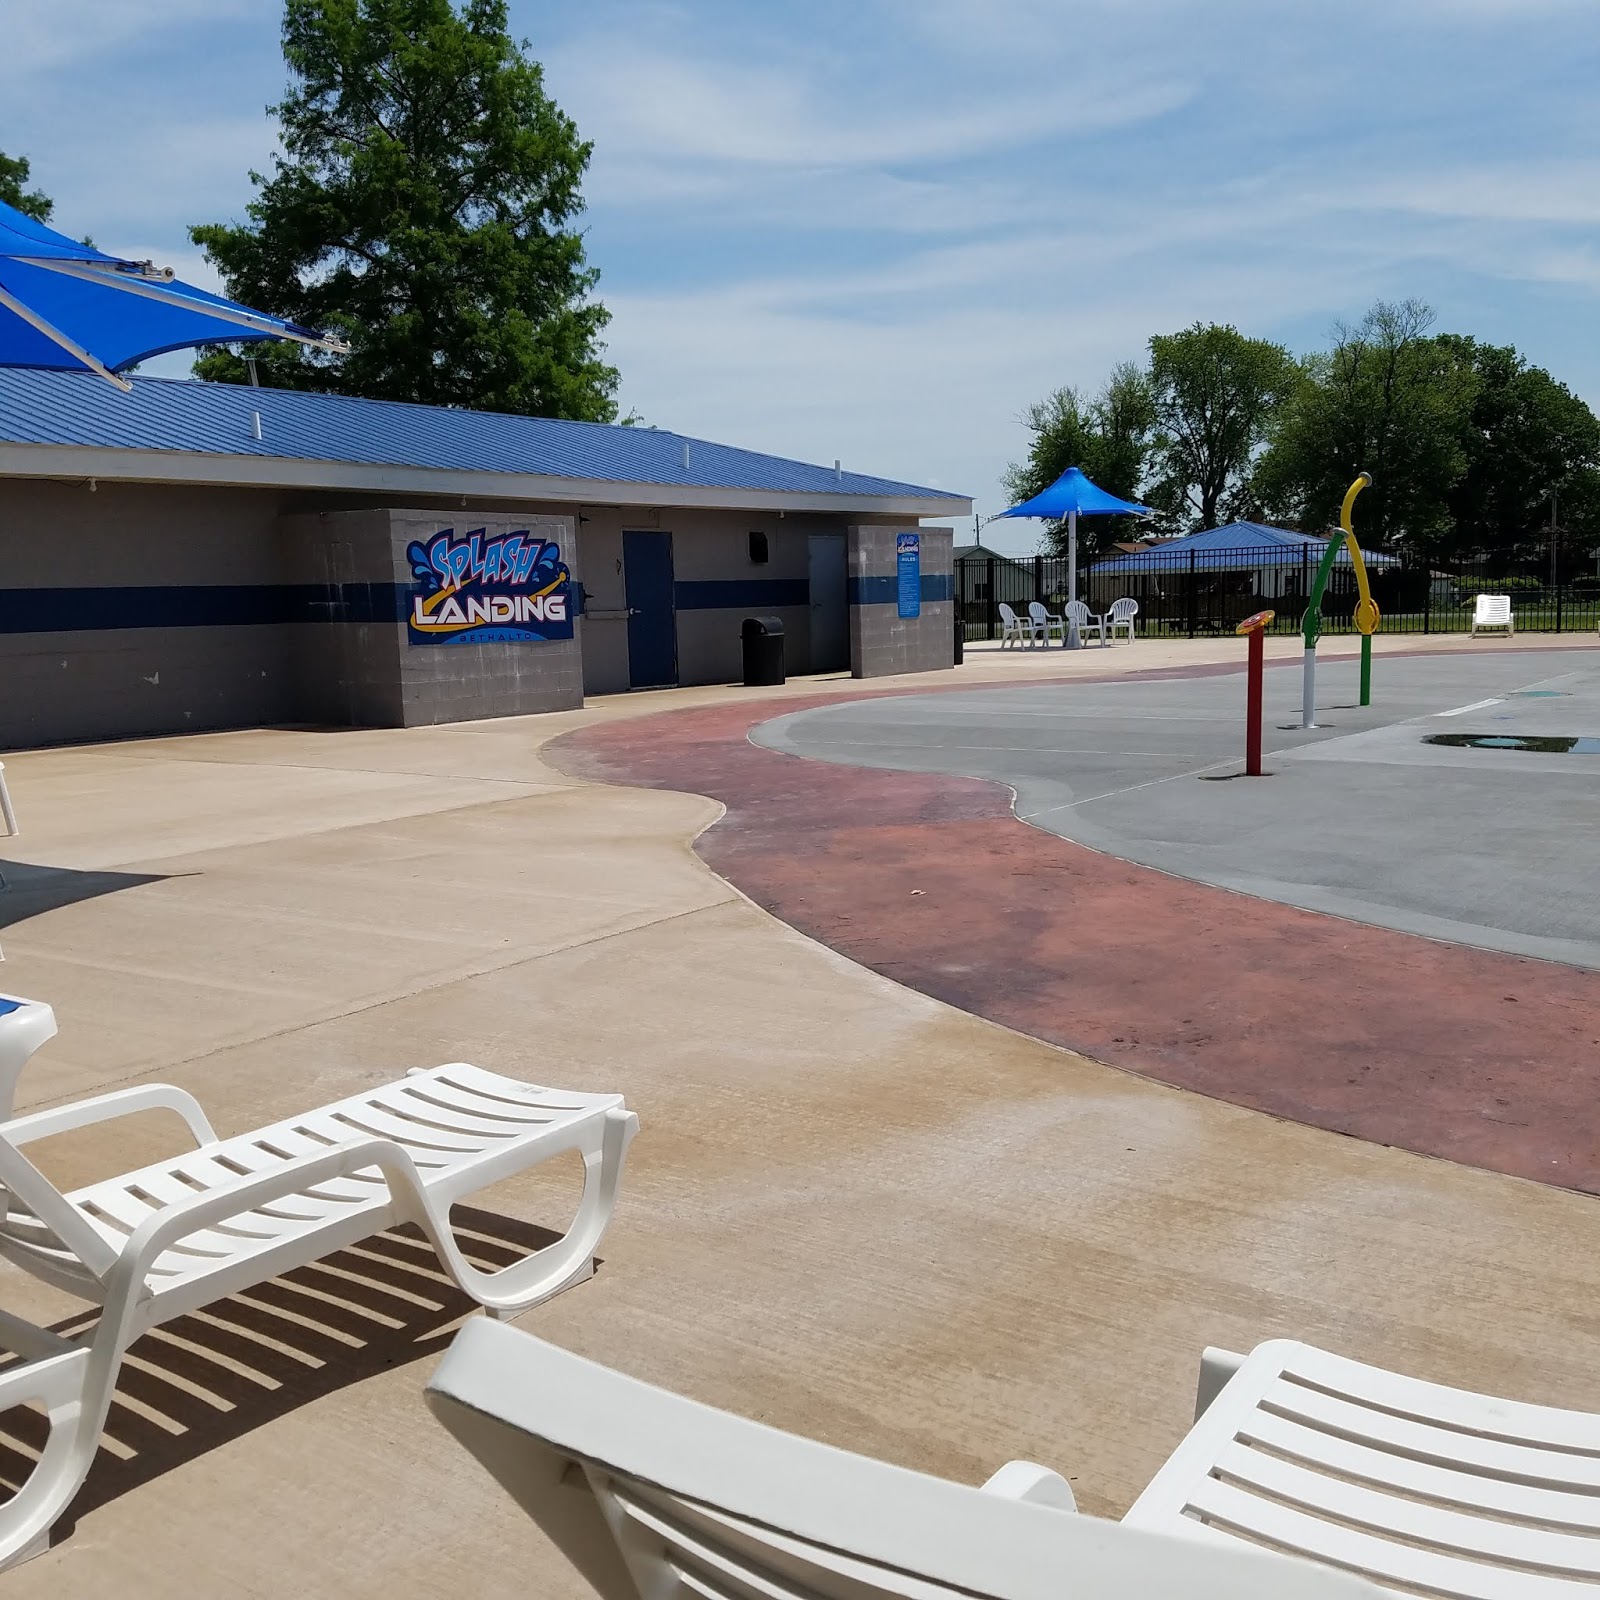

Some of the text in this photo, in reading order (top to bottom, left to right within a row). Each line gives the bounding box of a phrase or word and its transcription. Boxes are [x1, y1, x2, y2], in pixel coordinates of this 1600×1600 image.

[429, 533, 542, 592] SPLASH
[414, 595, 567, 625] LANDING
[459, 632, 533, 643] BETHALTO
